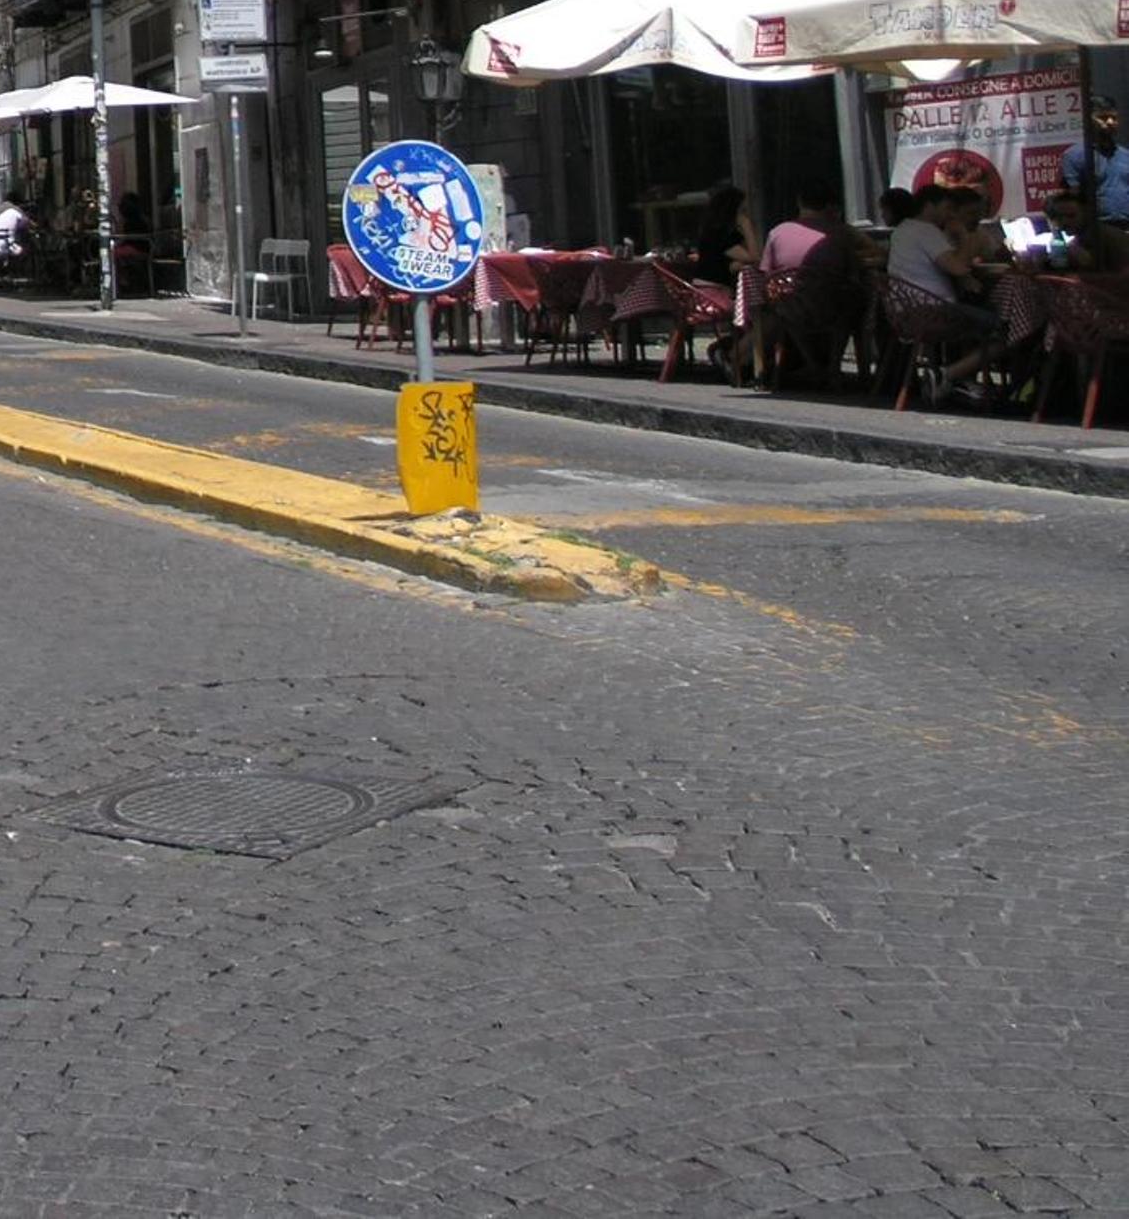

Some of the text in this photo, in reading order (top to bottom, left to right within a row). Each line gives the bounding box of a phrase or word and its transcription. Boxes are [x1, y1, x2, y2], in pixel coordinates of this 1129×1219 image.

[936, 77, 1013, 99] CONSEGNE
[1011, 78, 1021, 90] A
[1023, 68, 1081, 88] DOMICIL
[893, 105, 962, 132] DALLE
[1000, 94, 1057, 120] ALLE
[1065, 92, 1081, 113] 2
